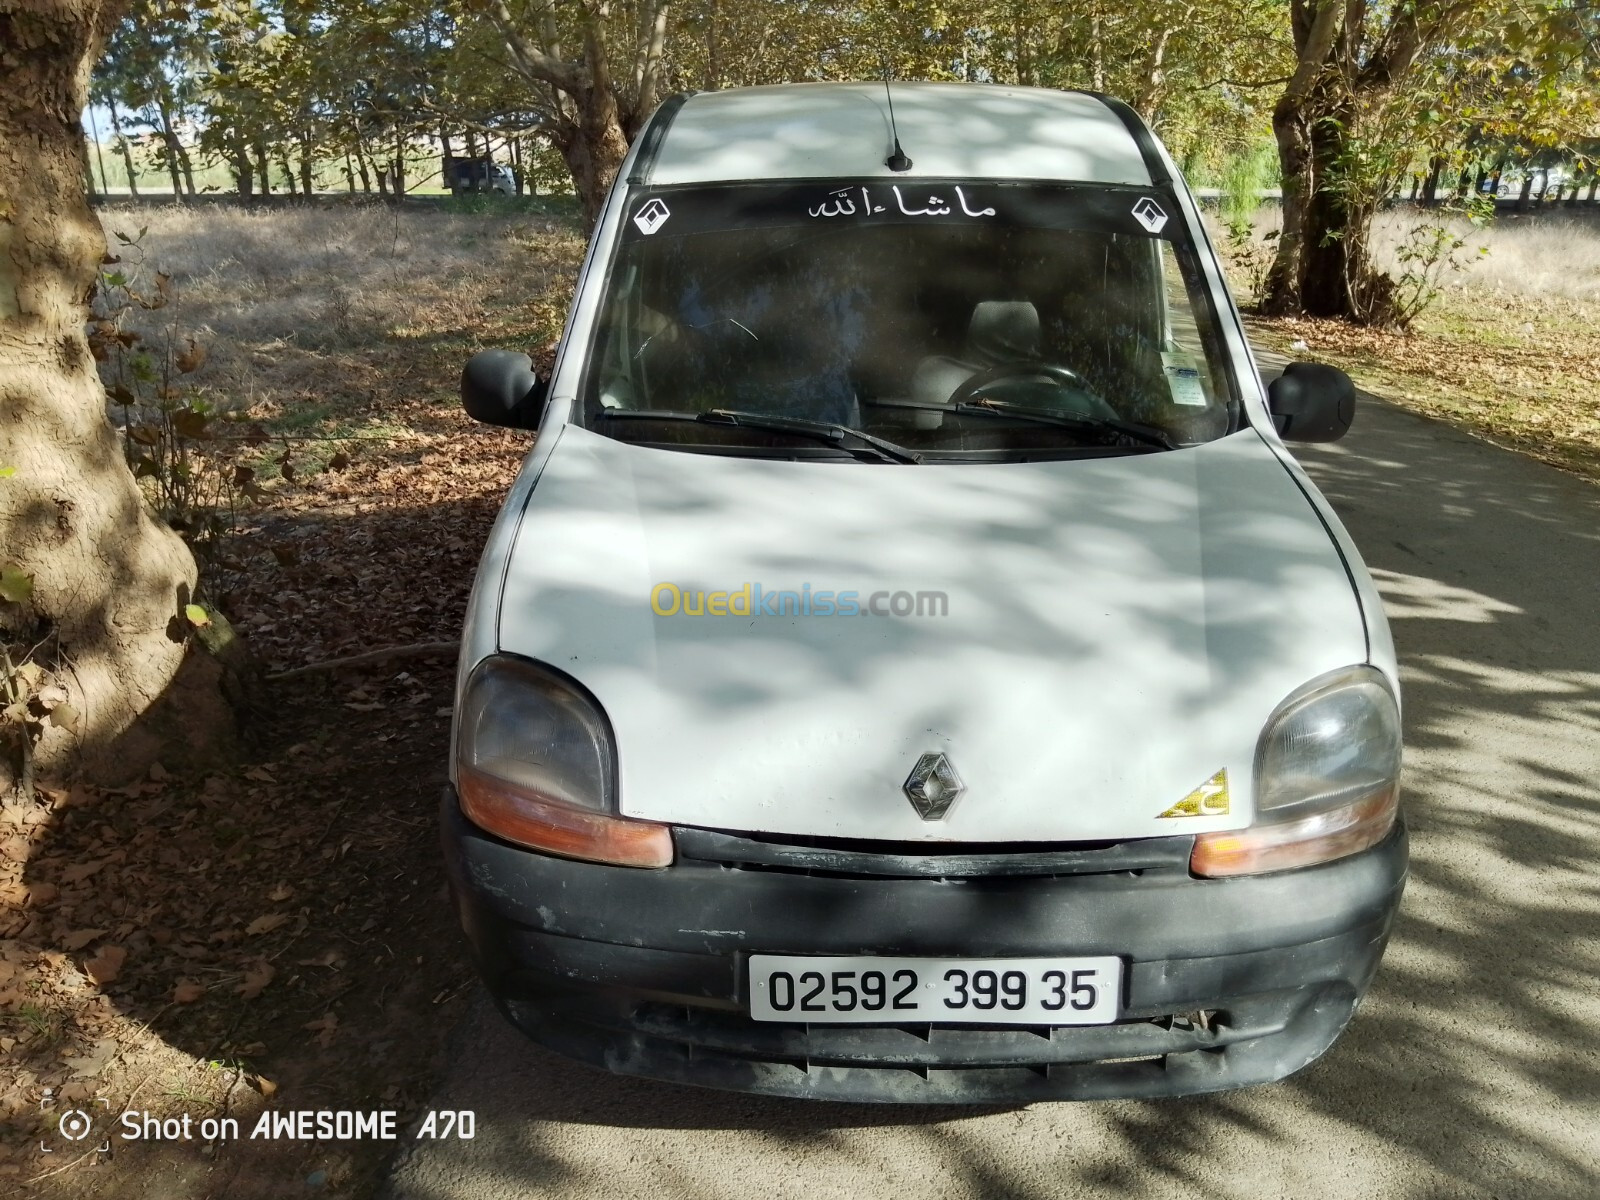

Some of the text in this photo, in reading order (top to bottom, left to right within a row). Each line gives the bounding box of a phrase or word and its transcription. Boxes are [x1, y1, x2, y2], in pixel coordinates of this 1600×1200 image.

[768, 969, 1097, 1012] 02592 399 35
